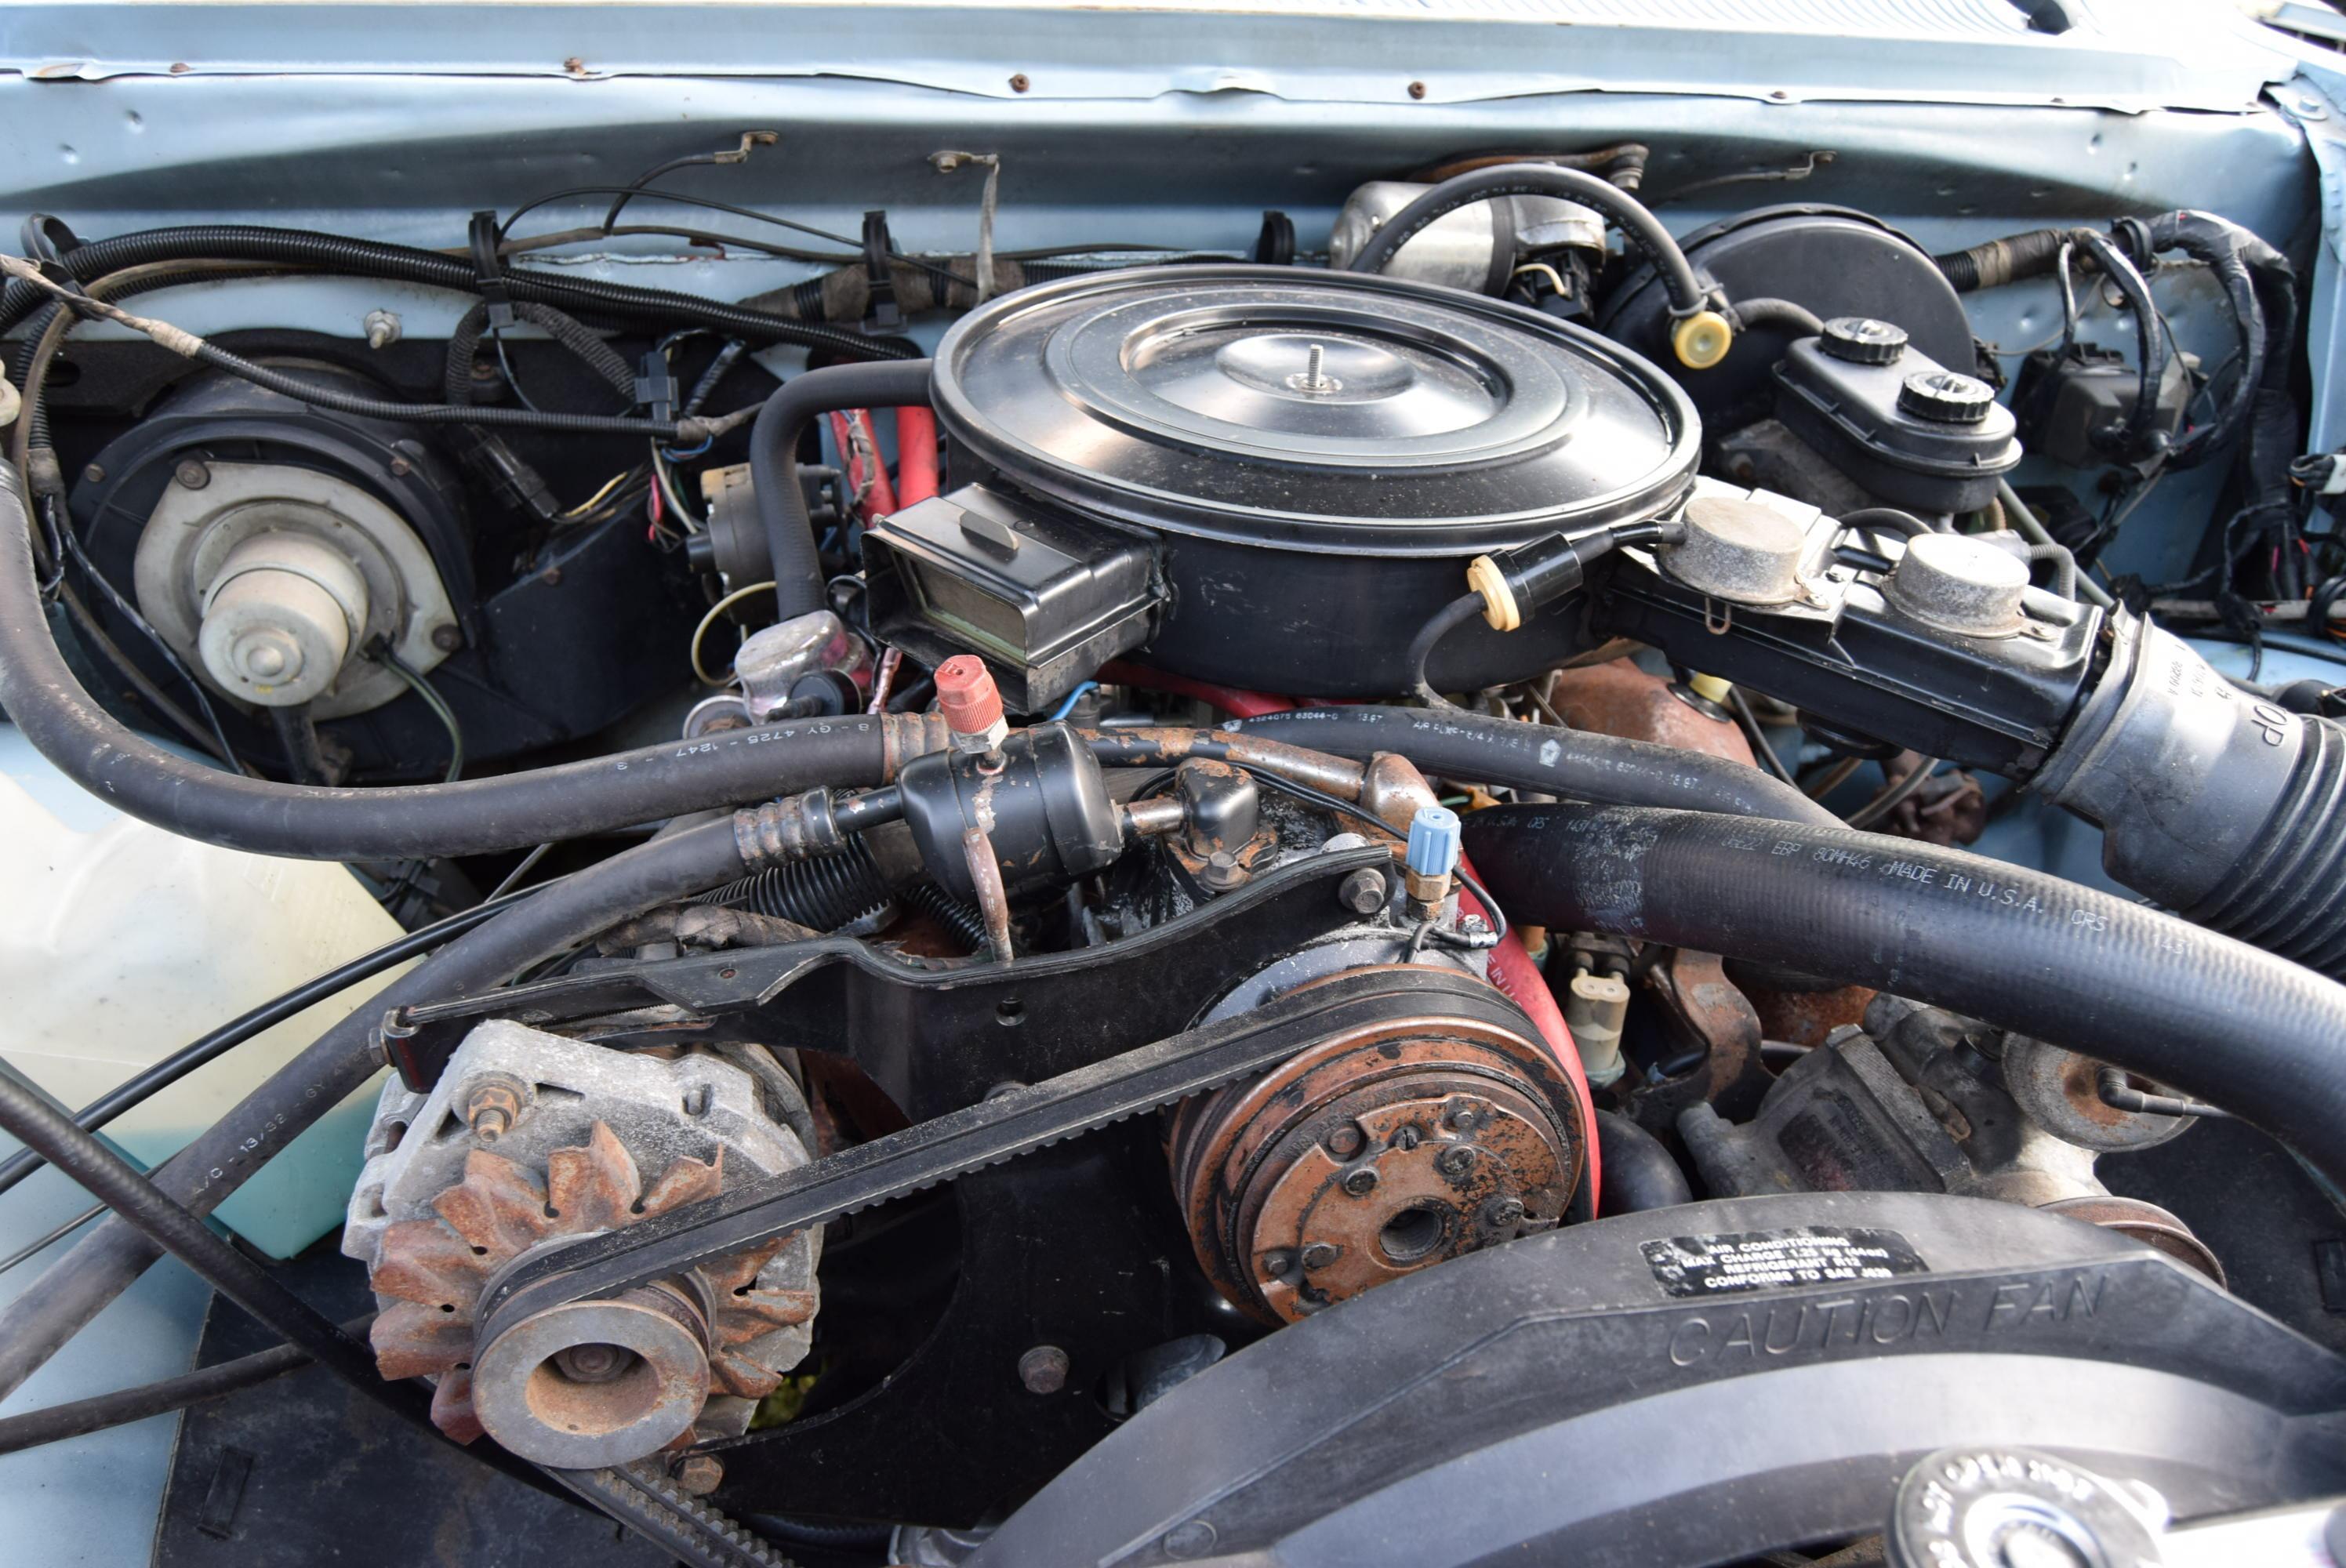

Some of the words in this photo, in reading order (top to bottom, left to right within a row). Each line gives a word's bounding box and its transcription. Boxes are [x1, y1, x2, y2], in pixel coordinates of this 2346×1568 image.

[808, 724, 831, 735] GY
[2250, 703, 2288, 747] OP
[747, 730, 795, 744] 4725
[675, 742, 718, 758] 1247
[1887, 861, 1935, 885] MADE
[1944, 873, 1973, 892] IN
[1977, 880, 2046, 915] U.S.A.
[2070, 909, 2110, 932] CRS
[1708, 1244, 1734, 1254] AIR
[1743, 1237, 1851, 1253] CONDITIONING
[1680, 1256, 1716, 1269] MAX
[1720, 1250, 1785, 1264] CHARGE
[1723, 1258, 1827, 1276] REFRIGERANT
[1832, 1257, 1863, 1268] R12
[1704, 1270, 1794, 1288] CONFORMS
[1795, 1269, 1821, 1281] TO
[1823, 1267, 1857, 1279] SAE
[1669, 1290, 1962, 1368] CAUTION
[1984, 1273, 2112, 1332] FAN
